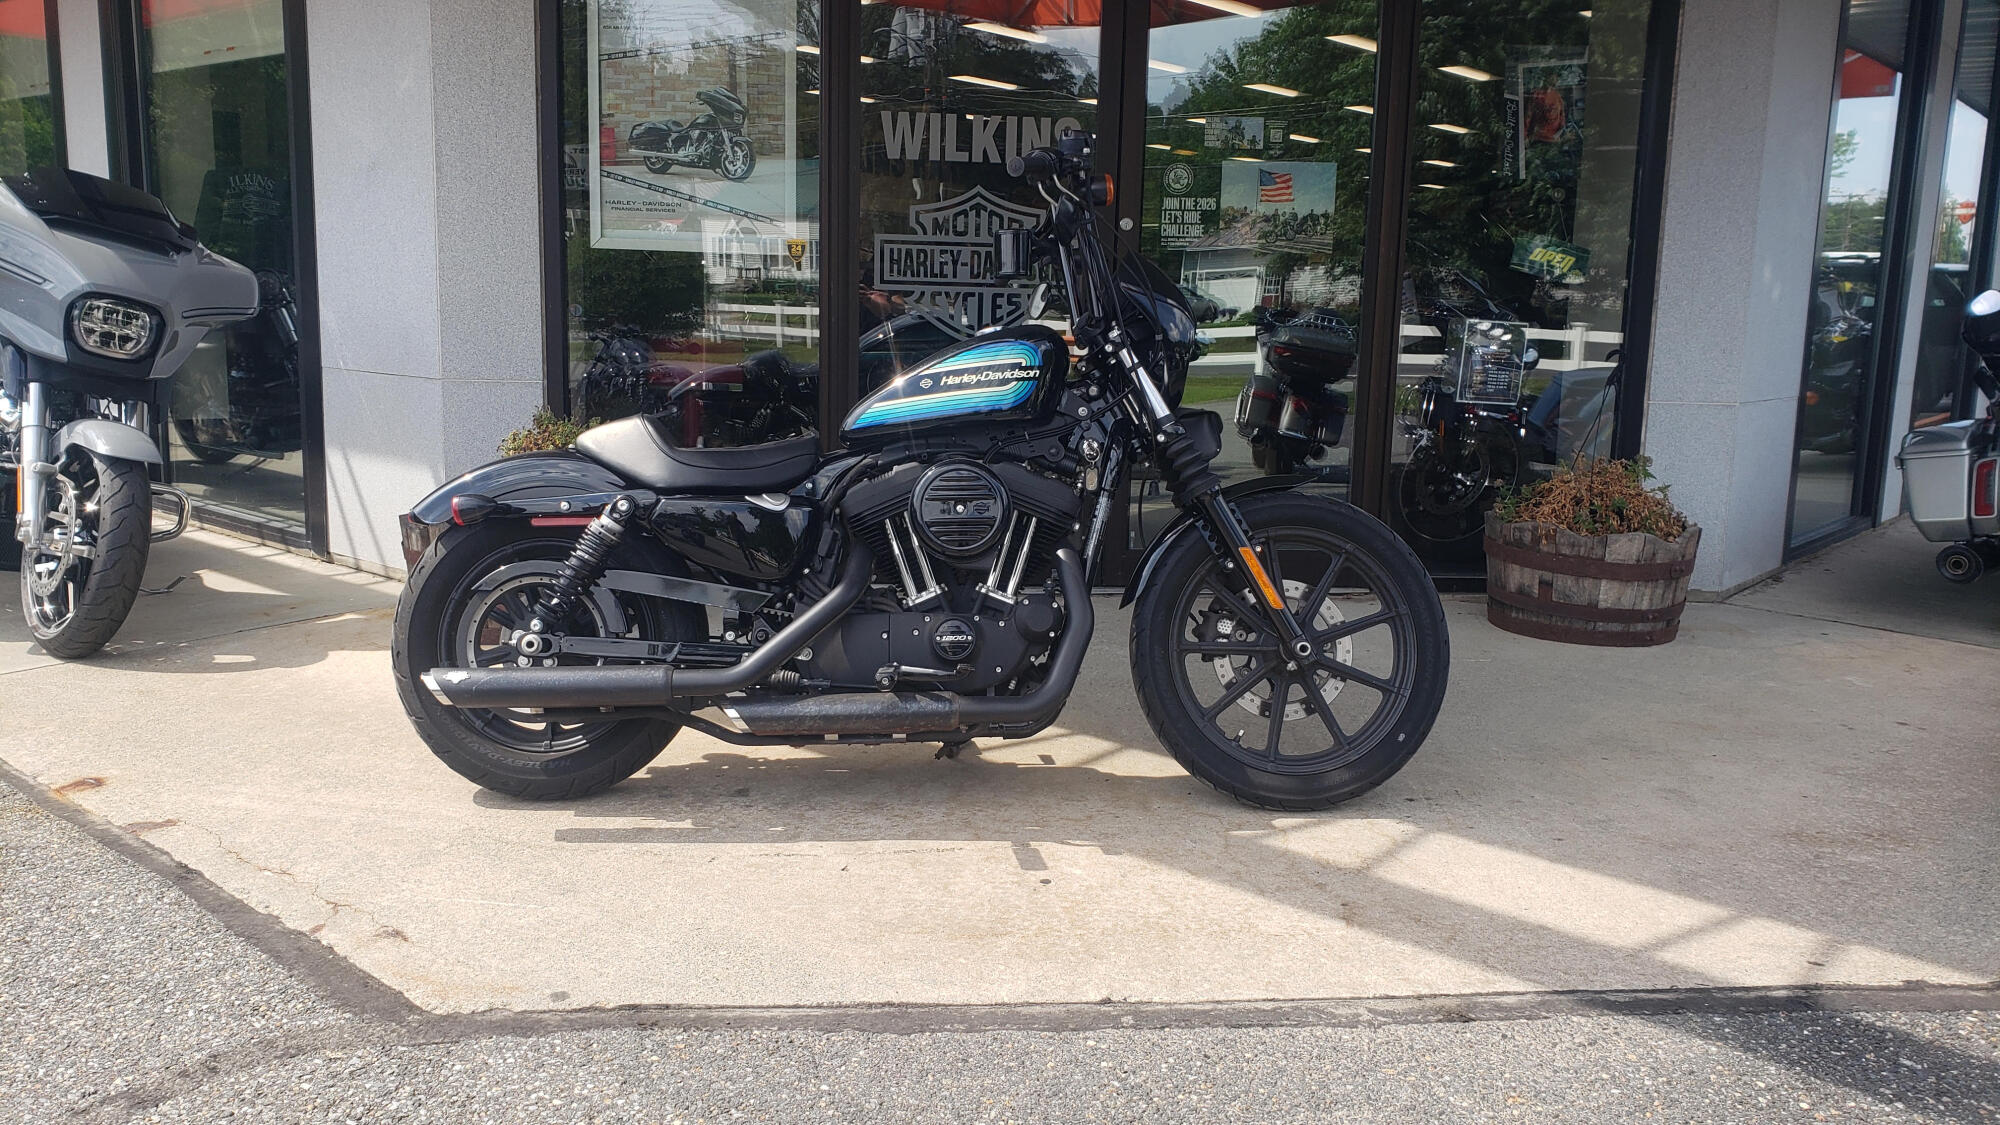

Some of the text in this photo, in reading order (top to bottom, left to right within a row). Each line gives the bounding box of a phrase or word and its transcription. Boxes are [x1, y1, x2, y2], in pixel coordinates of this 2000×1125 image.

[1161, 197, 1216, 210] JOIN THE 2026
[1161, 210, 1202, 224] LET'S RIDE
[1161, 224, 1205, 237] CHALLENGE
[889, 247, 1063, 281] HARLEY-DA
[1528, 247, 1577, 272] OPEN
[939, 367, 1041, 387] Harley-Davidson
